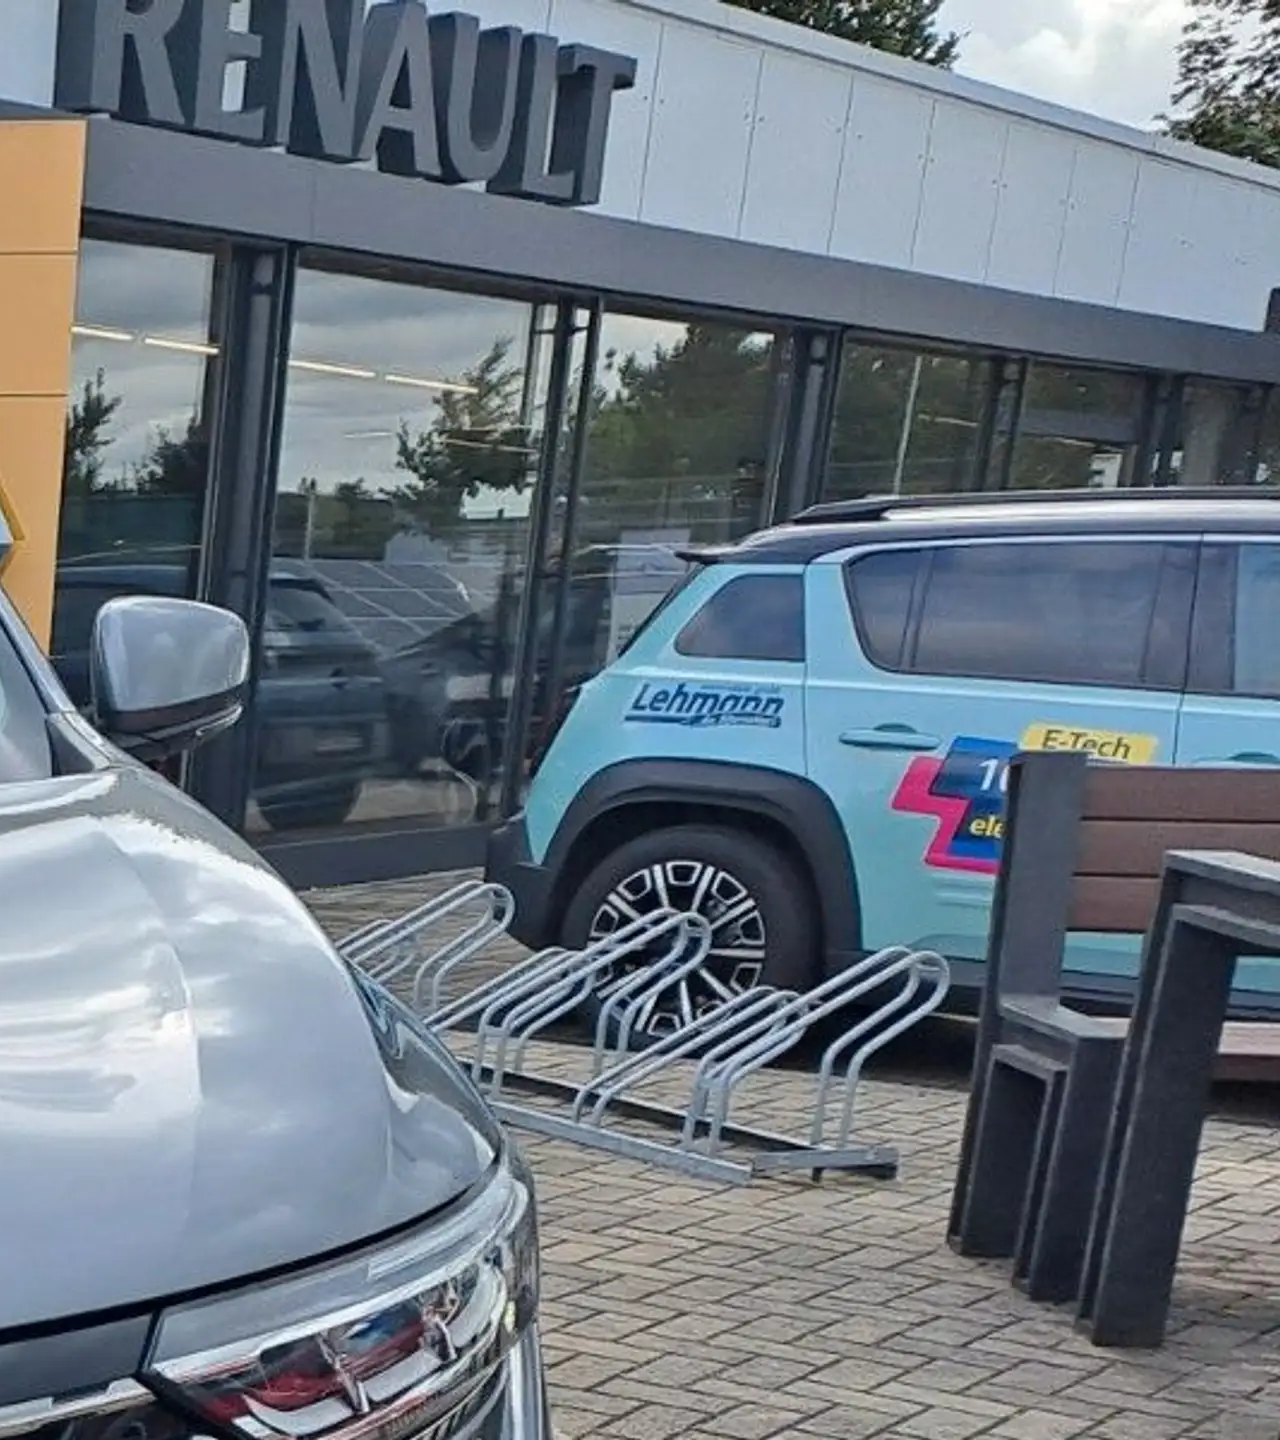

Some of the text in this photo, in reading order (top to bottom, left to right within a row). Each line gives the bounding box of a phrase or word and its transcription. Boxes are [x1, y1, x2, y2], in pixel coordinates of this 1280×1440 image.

[91, 0, 637, 205] RENAULT
[631, 682, 785, 716] Lehmann
[1041, 728, 1131, 760] E-Tech
